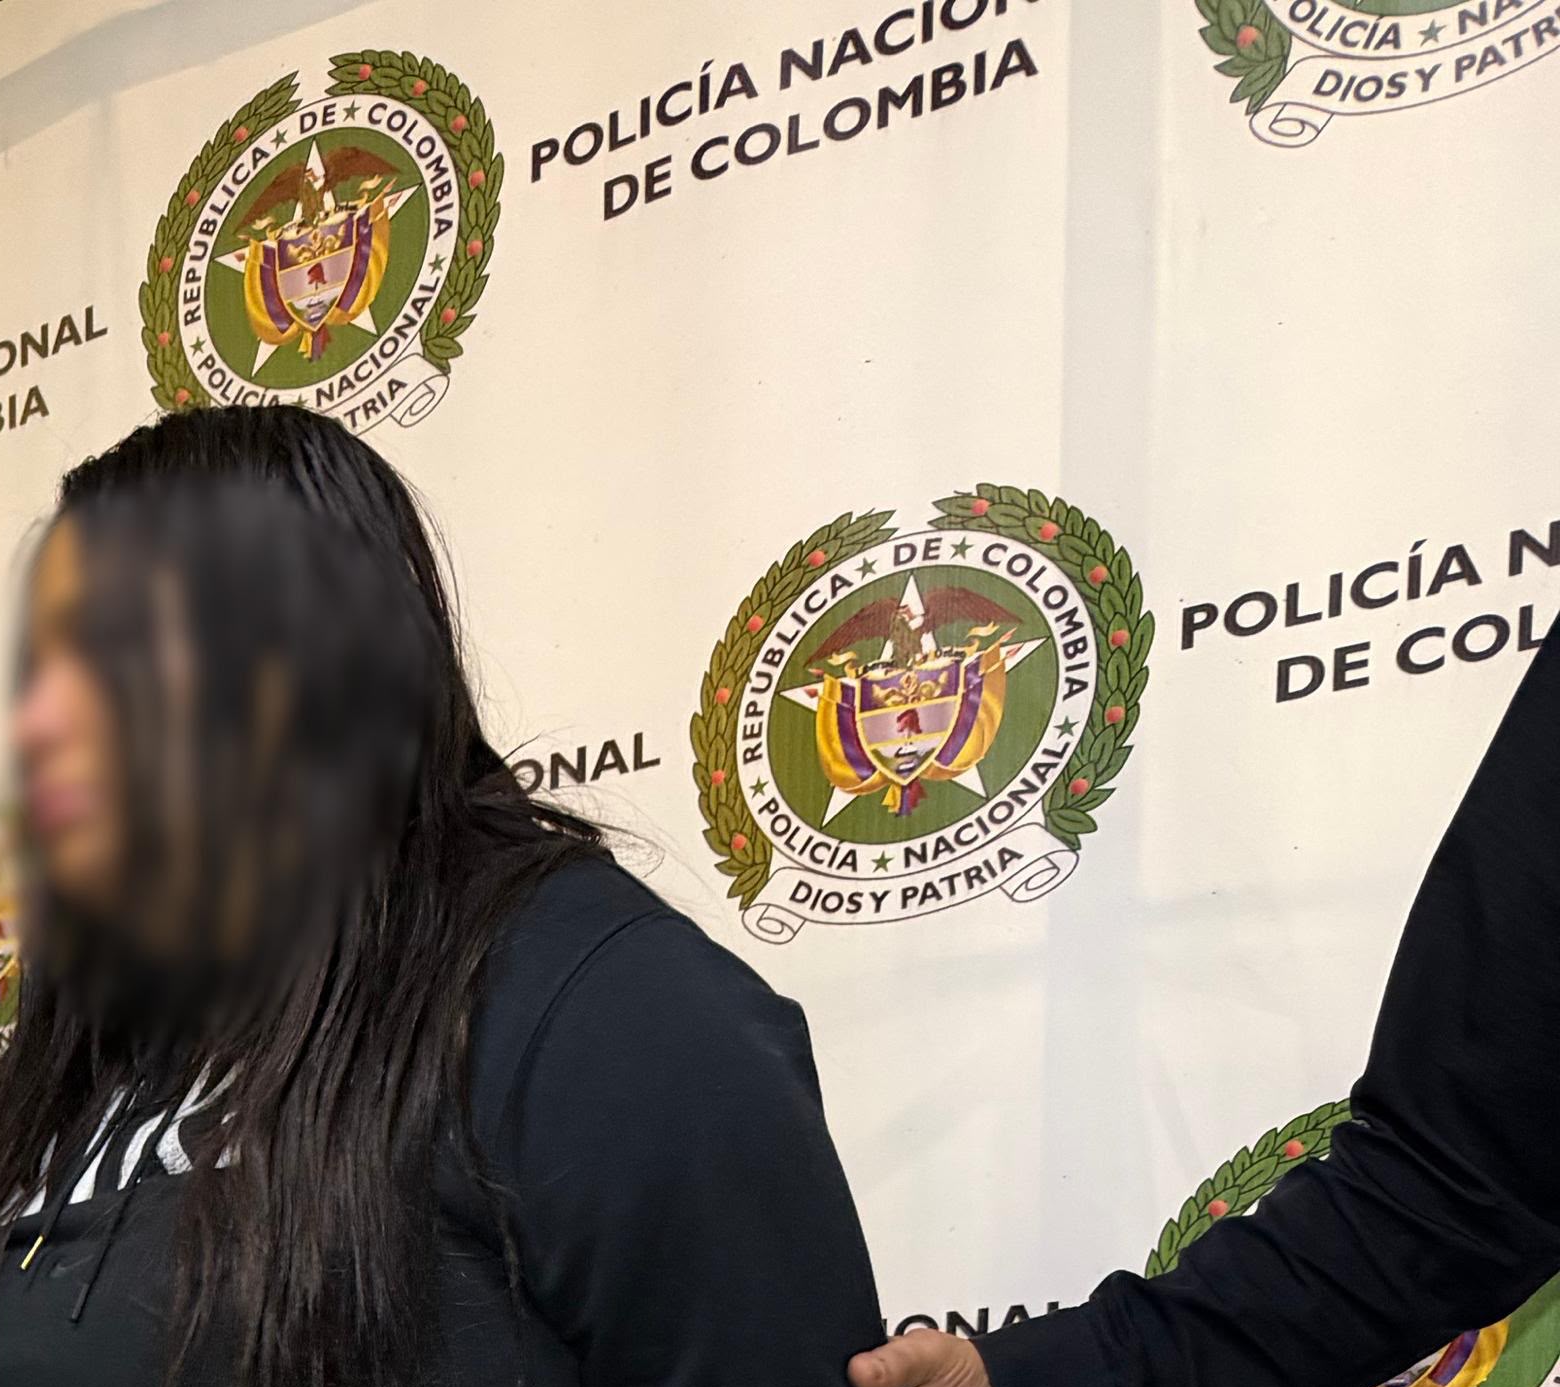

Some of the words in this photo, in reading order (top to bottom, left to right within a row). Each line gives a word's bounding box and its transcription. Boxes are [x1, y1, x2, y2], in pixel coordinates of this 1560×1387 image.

[1288, 0, 1401, 50] OLICÍA
[1455, 5, 1560, 83] PATR
[530, 58, 759, 183] POLICÍA
[780, 0, 1038, 91] NACIO
[603, 154, 672, 221] DE
[690, 38, 1039, 181] COLOMBIA
[300, 103, 337, 134] DE
[367, 102, 454, 240] COLOMBIA
[315, 276, 440, 407] NACIONAL
[344, 379, 408, 428] TRIA
[893, 538, 942, 566] DE
[982, 542, 1089, 701] COLOMBIA
[1181, 538, 1482, 650] POLICÍA
[1276, 641, 1371, 703] DE
[509, 732, 661, 795] ONAL
[903, 746, 1067, 868] NACIONAL
[900, 847, 1023, 909] PATRIA
